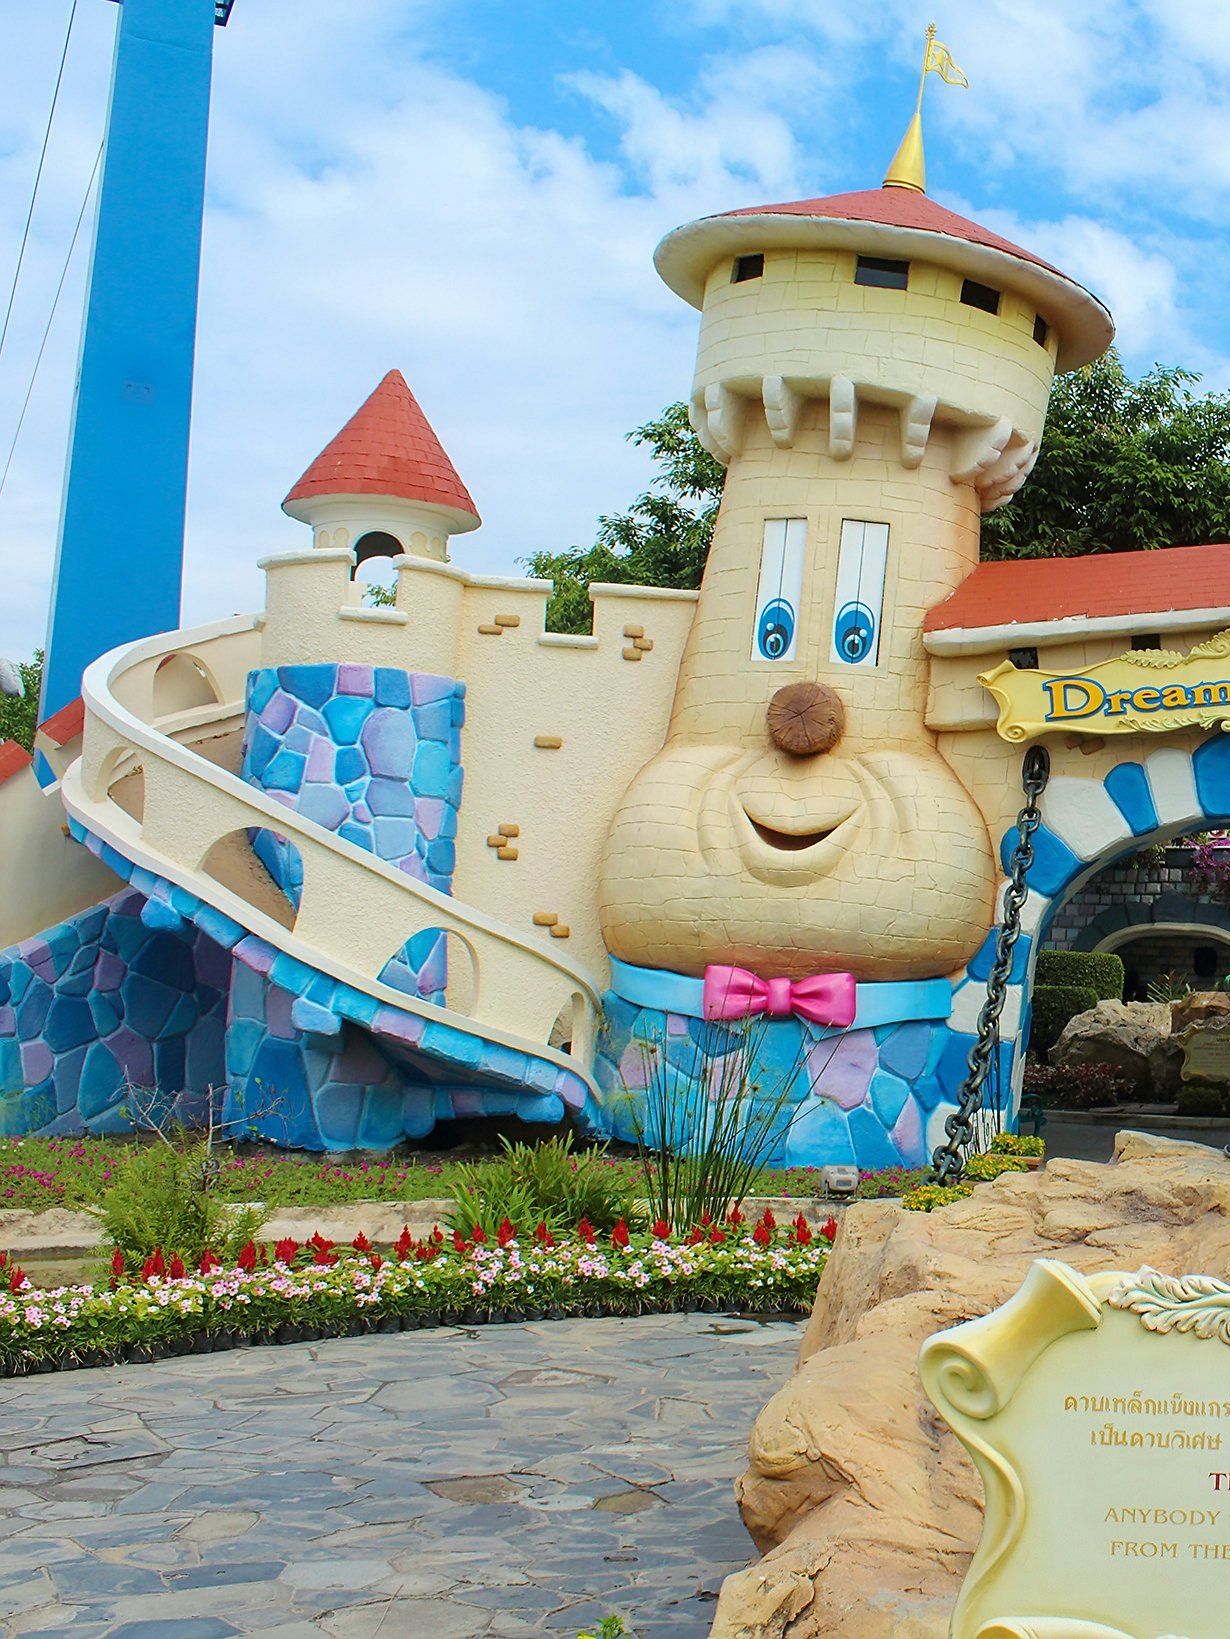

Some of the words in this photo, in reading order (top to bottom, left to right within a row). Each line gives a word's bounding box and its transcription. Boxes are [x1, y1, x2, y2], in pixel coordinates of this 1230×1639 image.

[1091, 1423, 1222, 1450] เป็นดาบวิเศษ
[1103, 1507, 1221, 1526] ANYBODY
[1110, 1540, 1178, 1558] FROM
